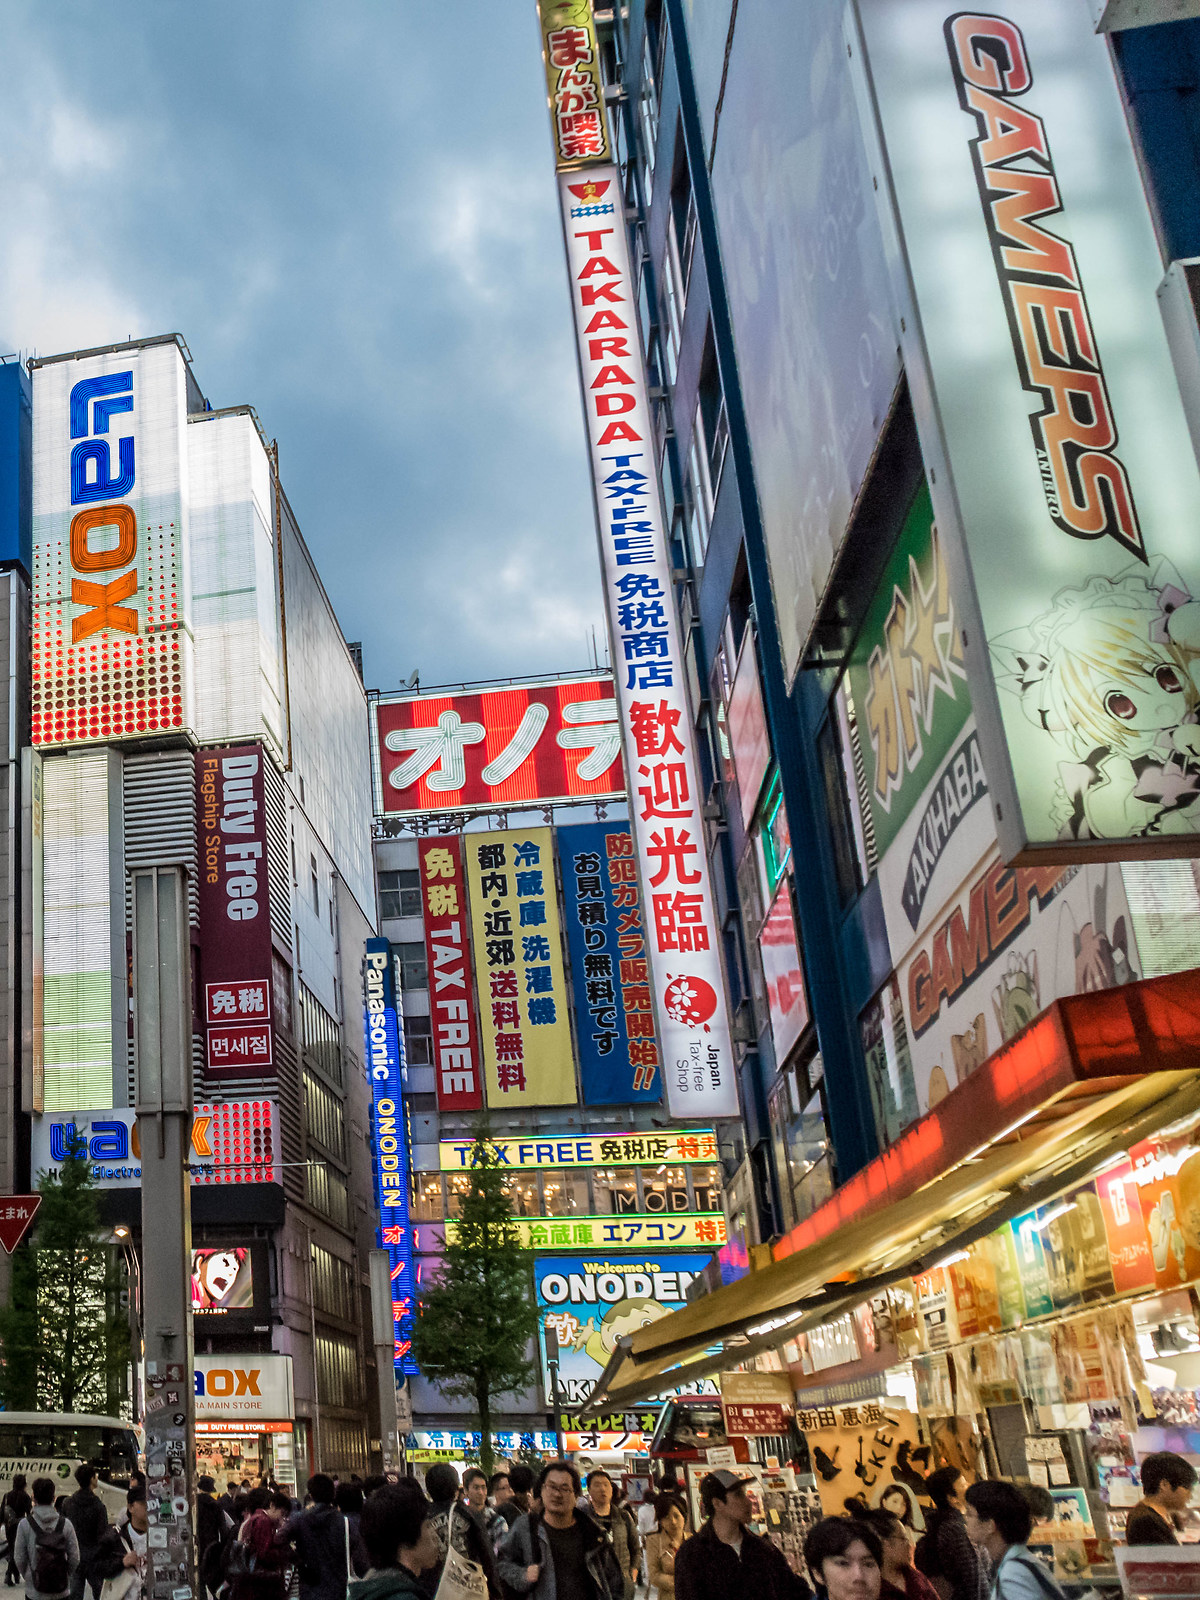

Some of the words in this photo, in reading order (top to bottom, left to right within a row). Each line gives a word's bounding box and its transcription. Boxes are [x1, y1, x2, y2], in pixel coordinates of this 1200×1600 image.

[548, 27, 604, 158] まんが喫茶
[945, 12, 1147, 564] GAMERS
[574, 228, 643, 446] TAKARADA
[601, 453, 656, 567] TAX-FREE
[615, 573, 673, 690] 免税商店
[203, 759, 218, 830] Flagship
[221, 754, 258, 834] Duty
[629, 697, 710, 954] 歓迎光臨
[205, 834, 219, 884] Store
[224, 844, 259, 921] Free
[424, 847, 460, 917] 免税
[430, 921, 466, 992] TAX
[572, 852, 620, 1056] お見積り無料です
[210, 989, 265, 1015] 免税
[366, 951, 389, 1081] Panasonic
[210, 1033, 269, 1059] 면세점
[436, 999, 475, 1094] FREE
[675, 1059, 689, 1093] Shop
[690, 1039, 705, 1092] Tax-free
[376, 1097, 402, 1208] ONODEN
[453, 1145, 512, 1167] TAX
[518, 1142, 594, 1164] FREE
[600, 1139, 669, 1162] 免税店
[528, 1224, 594, 1245] 冷蔵庫
[603, 1223, 687, 1243] エアコン
[582, 1262, 645, 1275] Welcome
[645, 1262, 661, 1274] to
[207, 1401, 231, 1410] MAIN
[232, 1401, 263, 1410] STORE
[210, 1423, 227, 1431] DUTY
[228, 1423, 244, 1431] FREE
[245, 1423, 266, 1431] STORE
